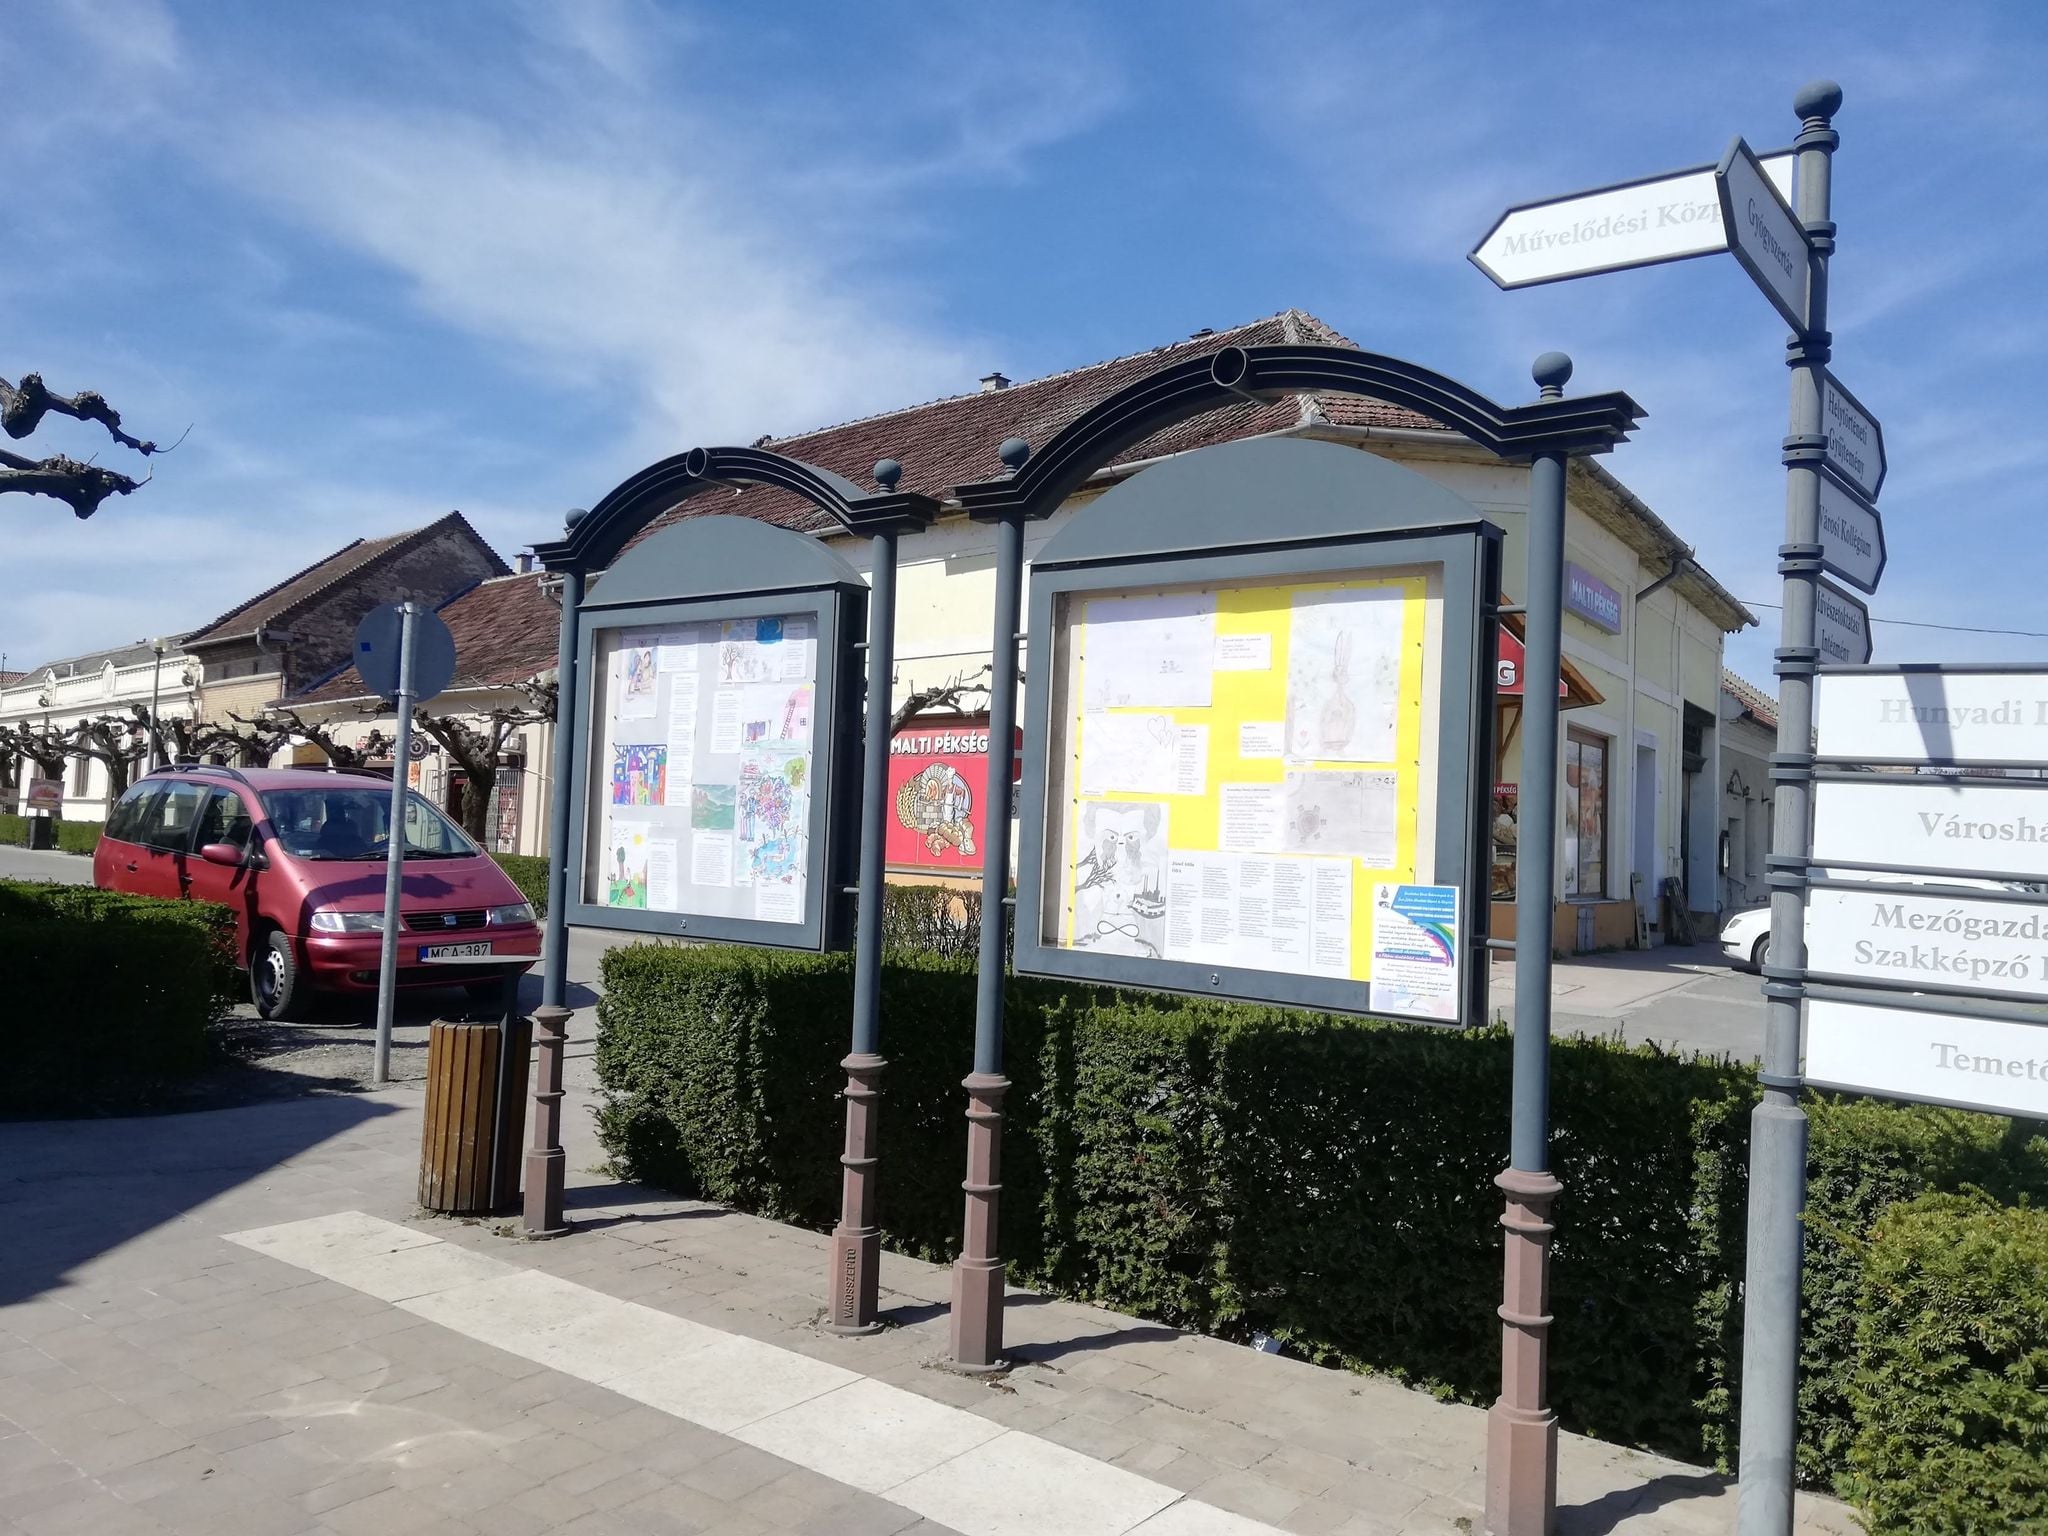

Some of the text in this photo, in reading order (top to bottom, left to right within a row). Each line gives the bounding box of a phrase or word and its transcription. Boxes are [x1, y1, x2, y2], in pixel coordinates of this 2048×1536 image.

[1501, 208, 1649, 257] Művelődési
[1748, 197, 1794, 280] Gyógyszertár
[1841, 518, 1872, 559] Kollégium
[1821, 628, 1851, 663] Intézmény
[1879, 698, 2024, 730] Hunyadi
[890, 730, 989, 755] MALTI PÉKSÉG
[1854, 939, 2032, 981] Szakképző
